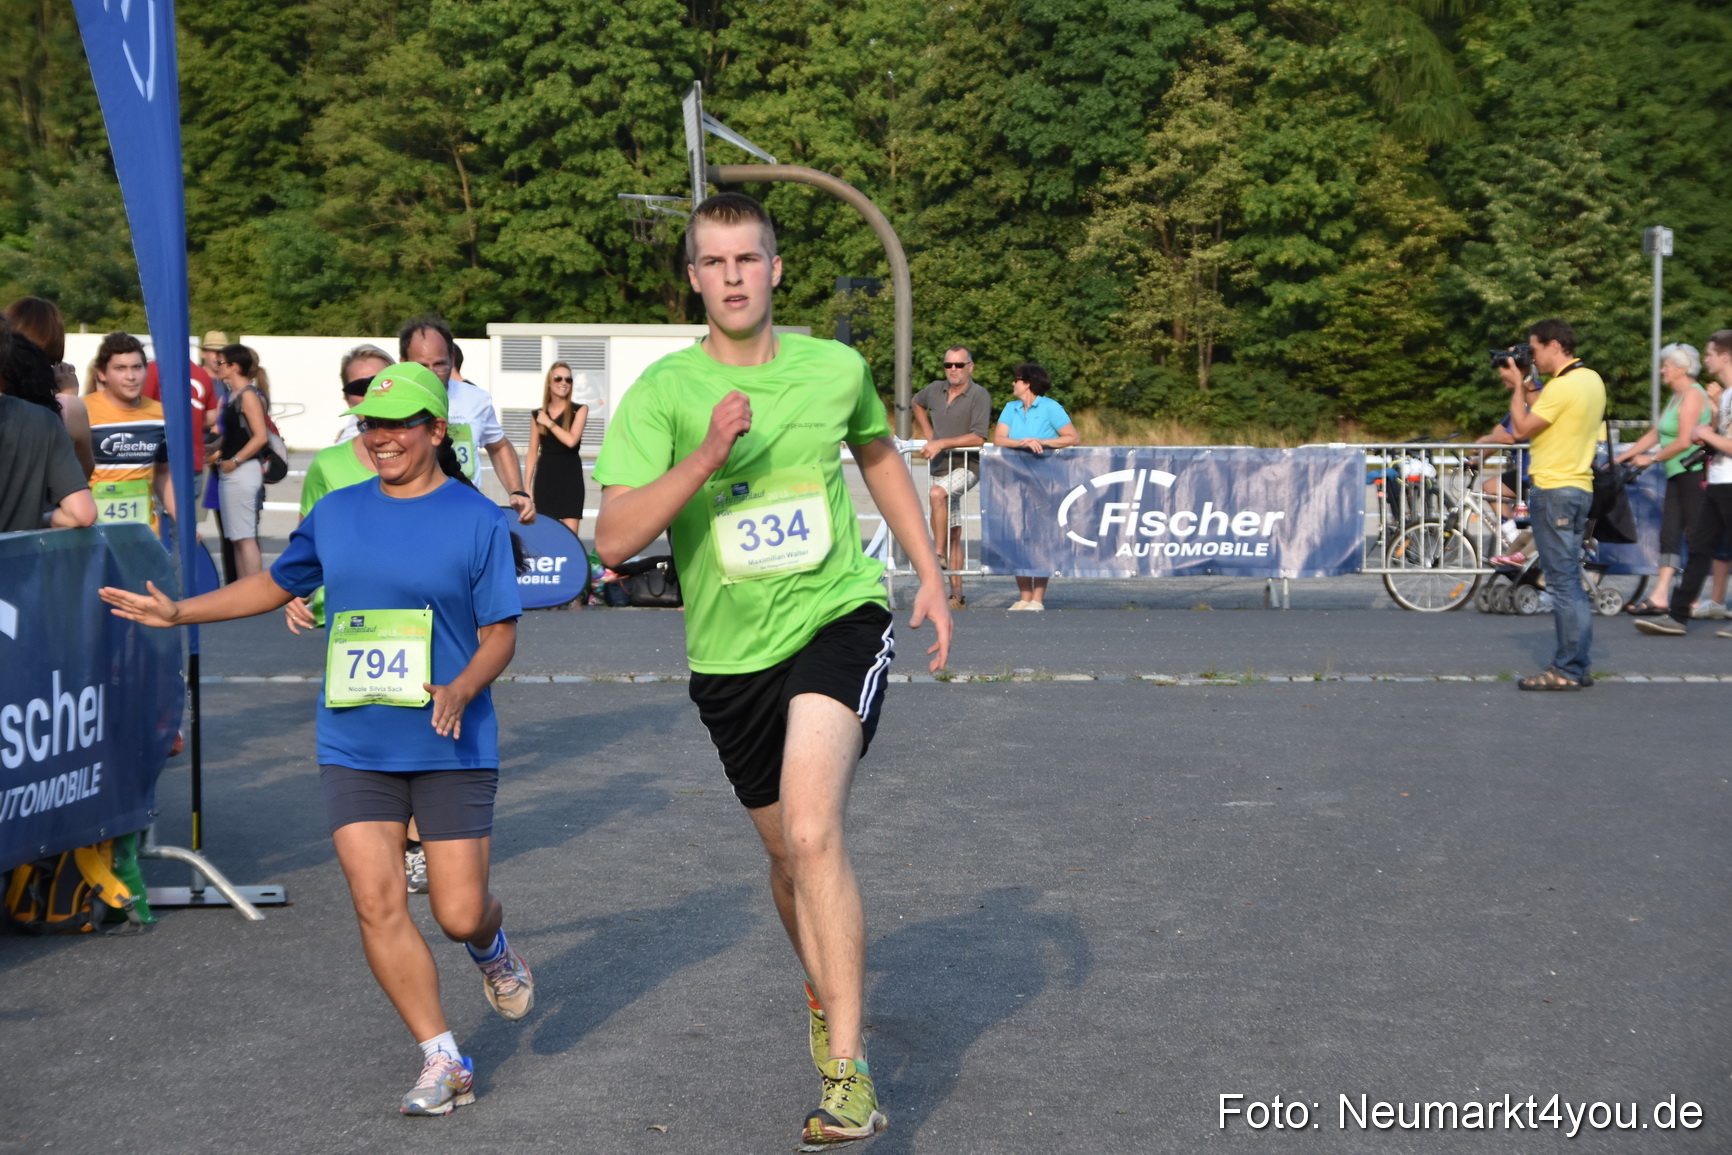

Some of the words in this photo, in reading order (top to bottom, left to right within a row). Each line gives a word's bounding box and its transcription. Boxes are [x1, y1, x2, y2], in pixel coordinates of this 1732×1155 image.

[112, 440, 158, 452] Fischer
[104, 501, 138, 519] 451
[1098, 501, 1285, 538] Fischer
[737, 508, 811, 552] 334
[1114, 541, 1270, 558] AUTOMOBILE
[347, 648, 409, 680] 794
